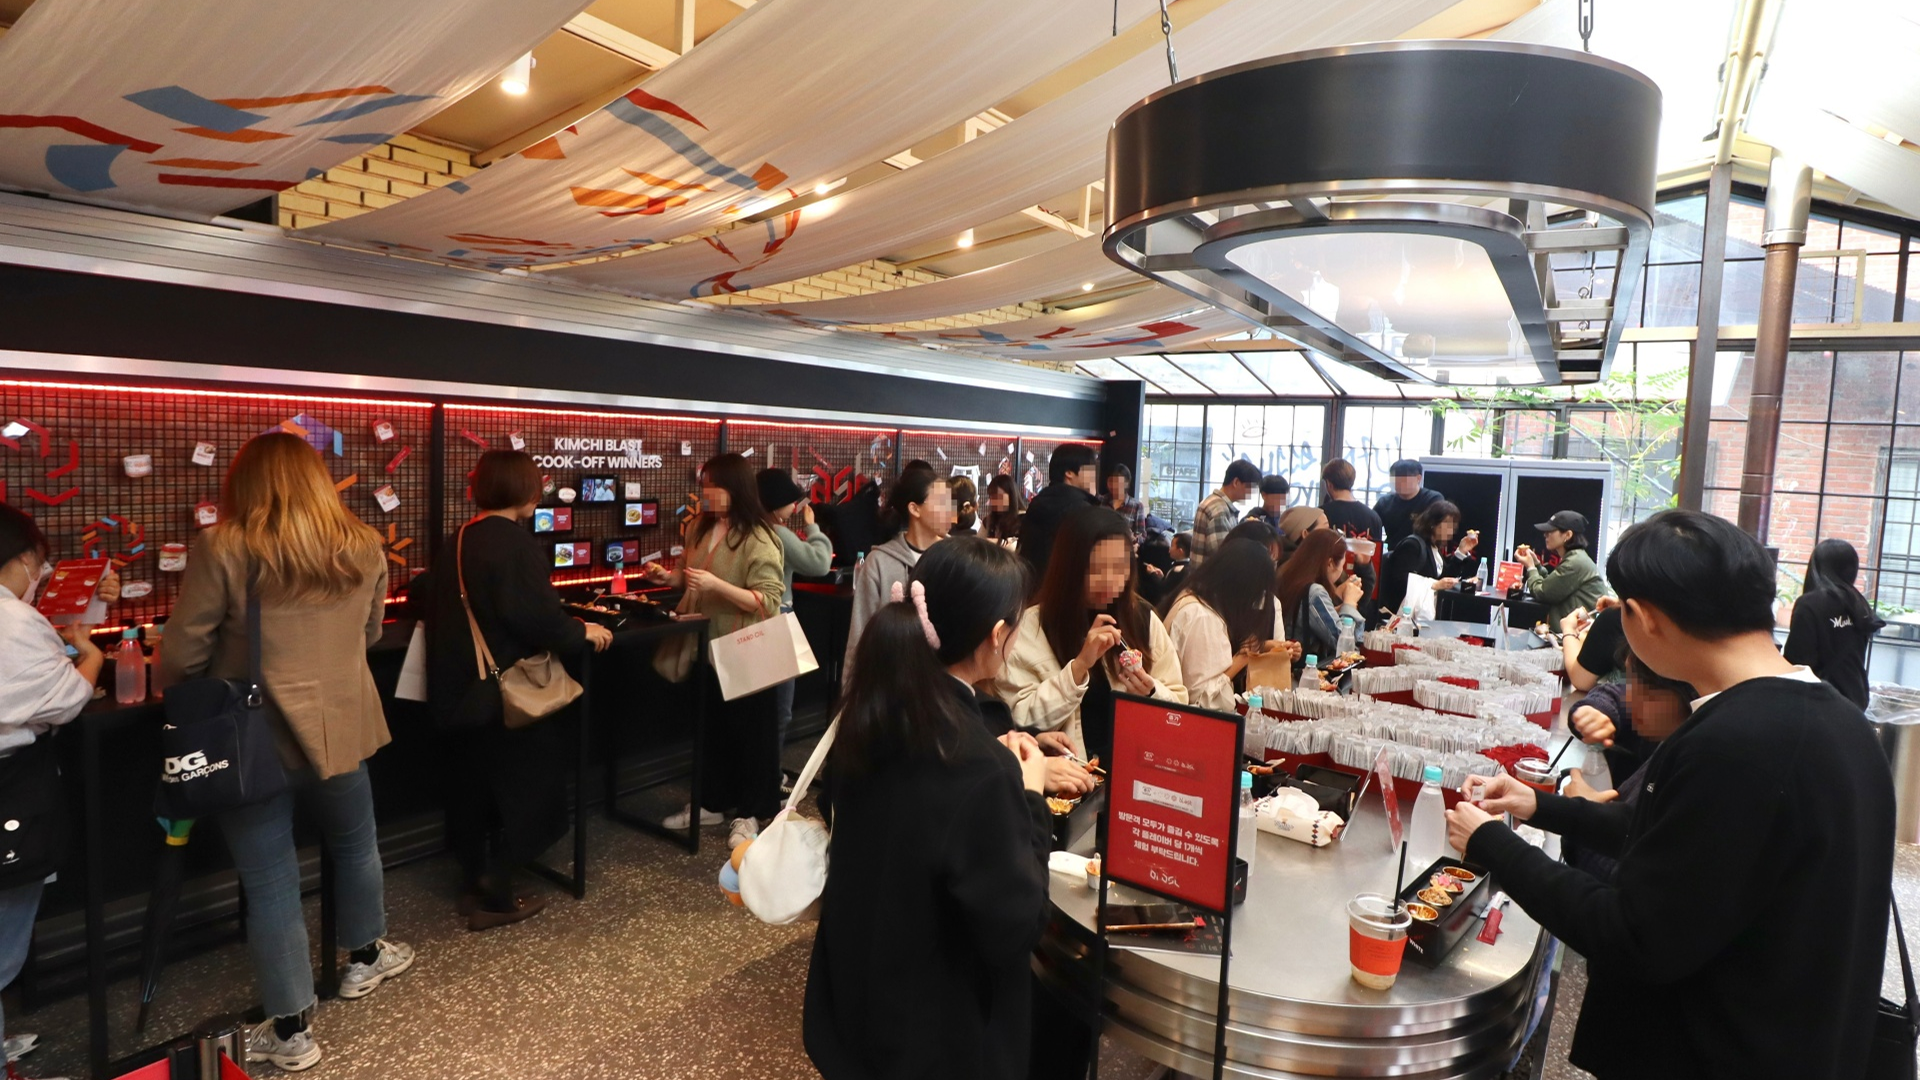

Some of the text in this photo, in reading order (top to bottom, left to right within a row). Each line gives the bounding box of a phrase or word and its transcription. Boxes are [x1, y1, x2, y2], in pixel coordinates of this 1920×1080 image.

[554, 438, 642, 451] KIMCHI BLAST
[607, 455, 662, 468] WINNERS
[736, 634, 754, 645] STAND
[181, 759, 229, 782] GARÇONS
[1118, 811, 1219, 848] 방문객 모두가 즐길 수 있도록
[1132, 827, 1203, 856] 각 플레이버 당 1개씩
[1133, 839, 1149, 853] 체험
